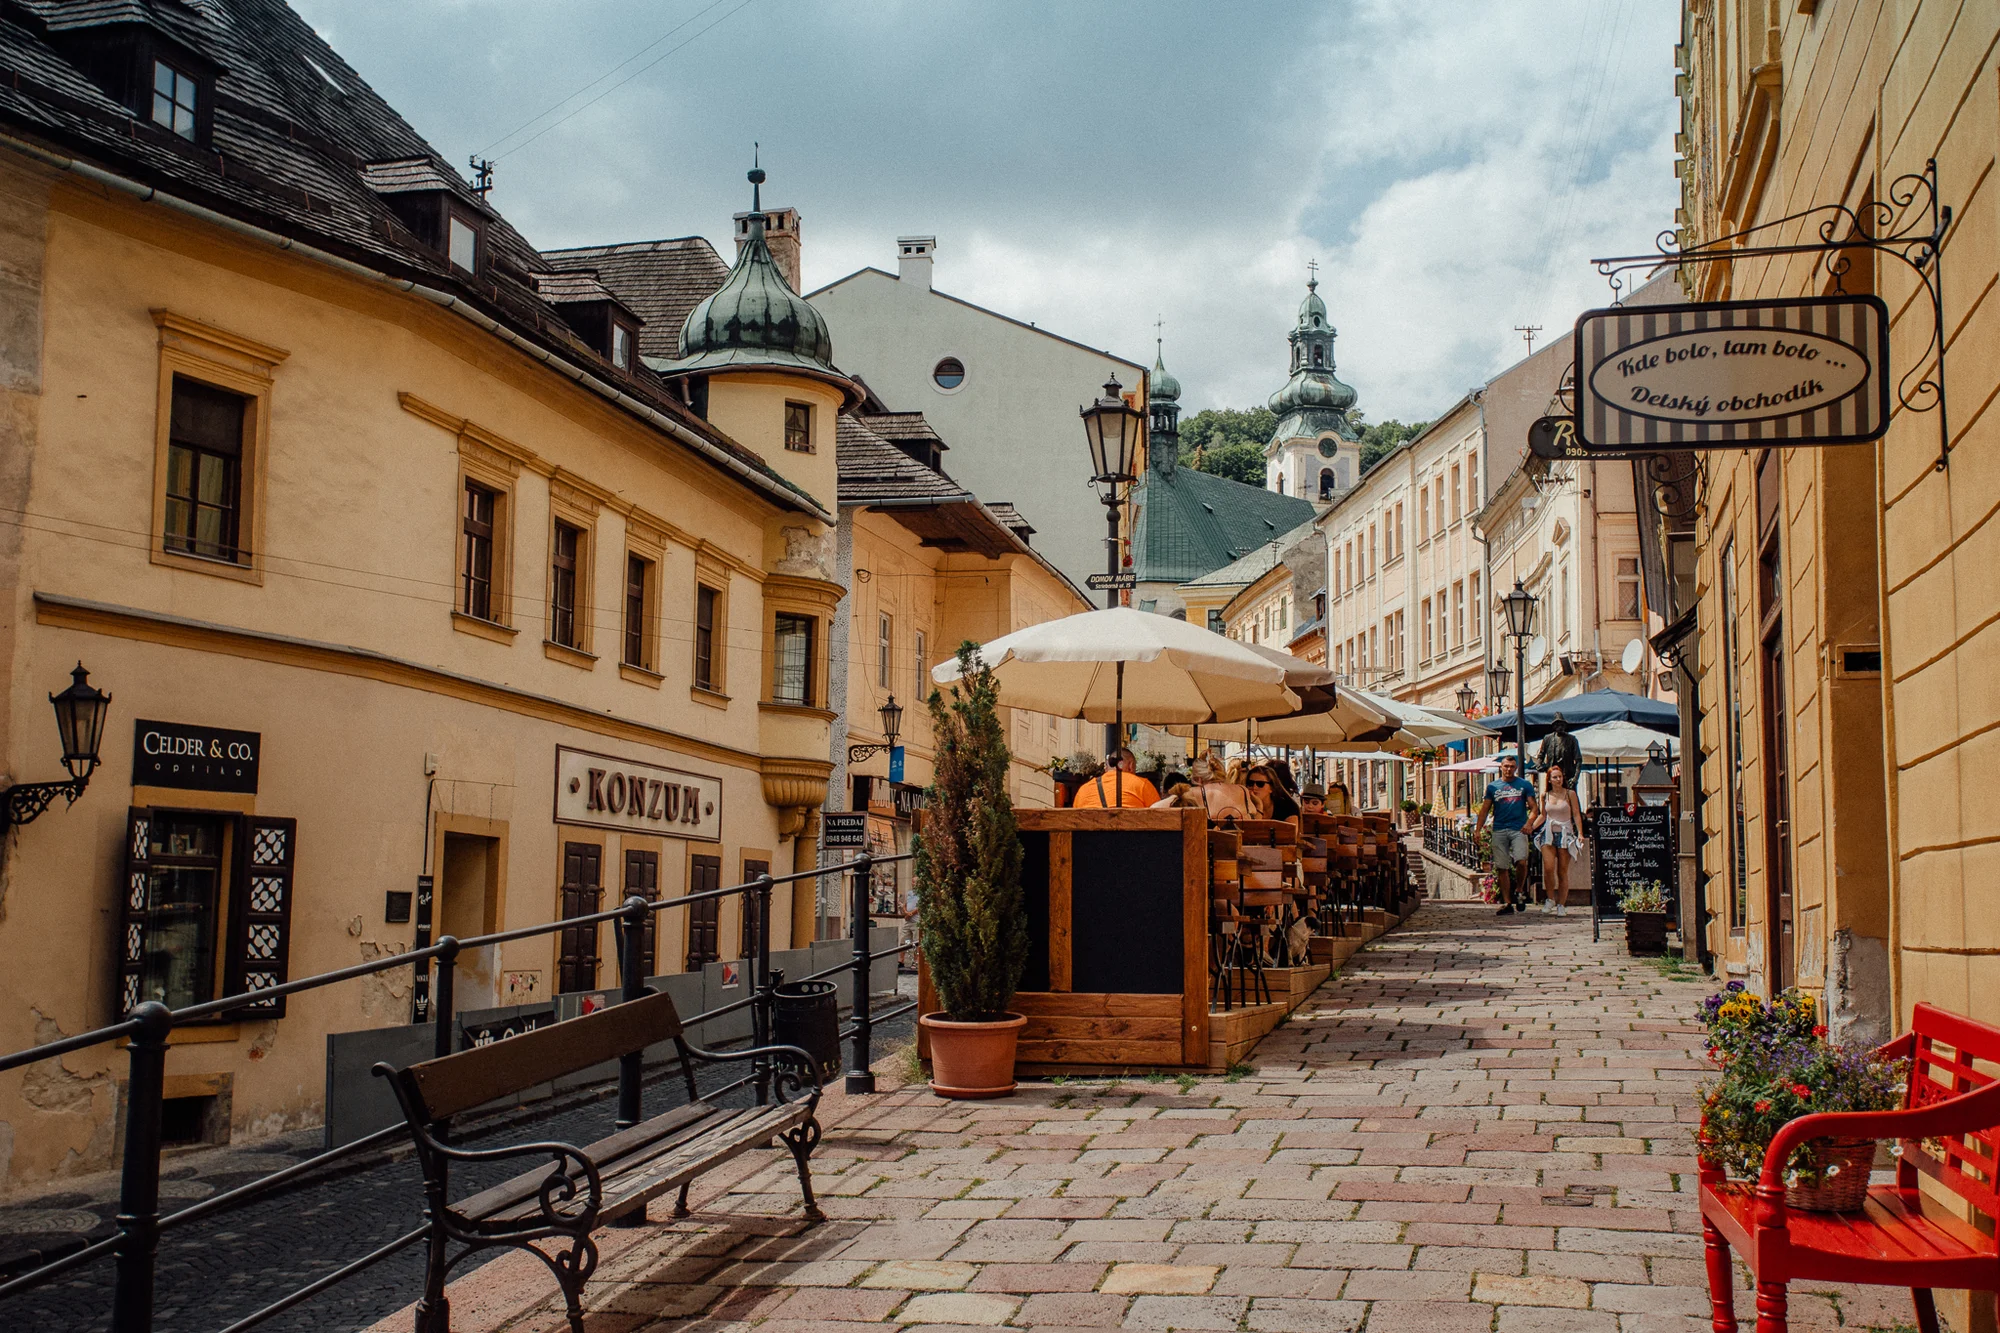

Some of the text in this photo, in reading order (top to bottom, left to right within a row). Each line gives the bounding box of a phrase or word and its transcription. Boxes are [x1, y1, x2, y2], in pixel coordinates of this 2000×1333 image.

[1618, 353, 1659, 378] Kde
[1724, 340, 1766, 356] tam
[1773, 340, 1820, 361] bolo
[1631, 379, 1824, 416] Detský obchodík
[1115, 574, 1135, 582] MÁRIE
[143, 731, 253, 761] CELDER & CO.
[154, 763, 241, 776] optika
[587, 768, 700, 825] KONZUM
[826, 818, 864, 826] NA PREDAJ
